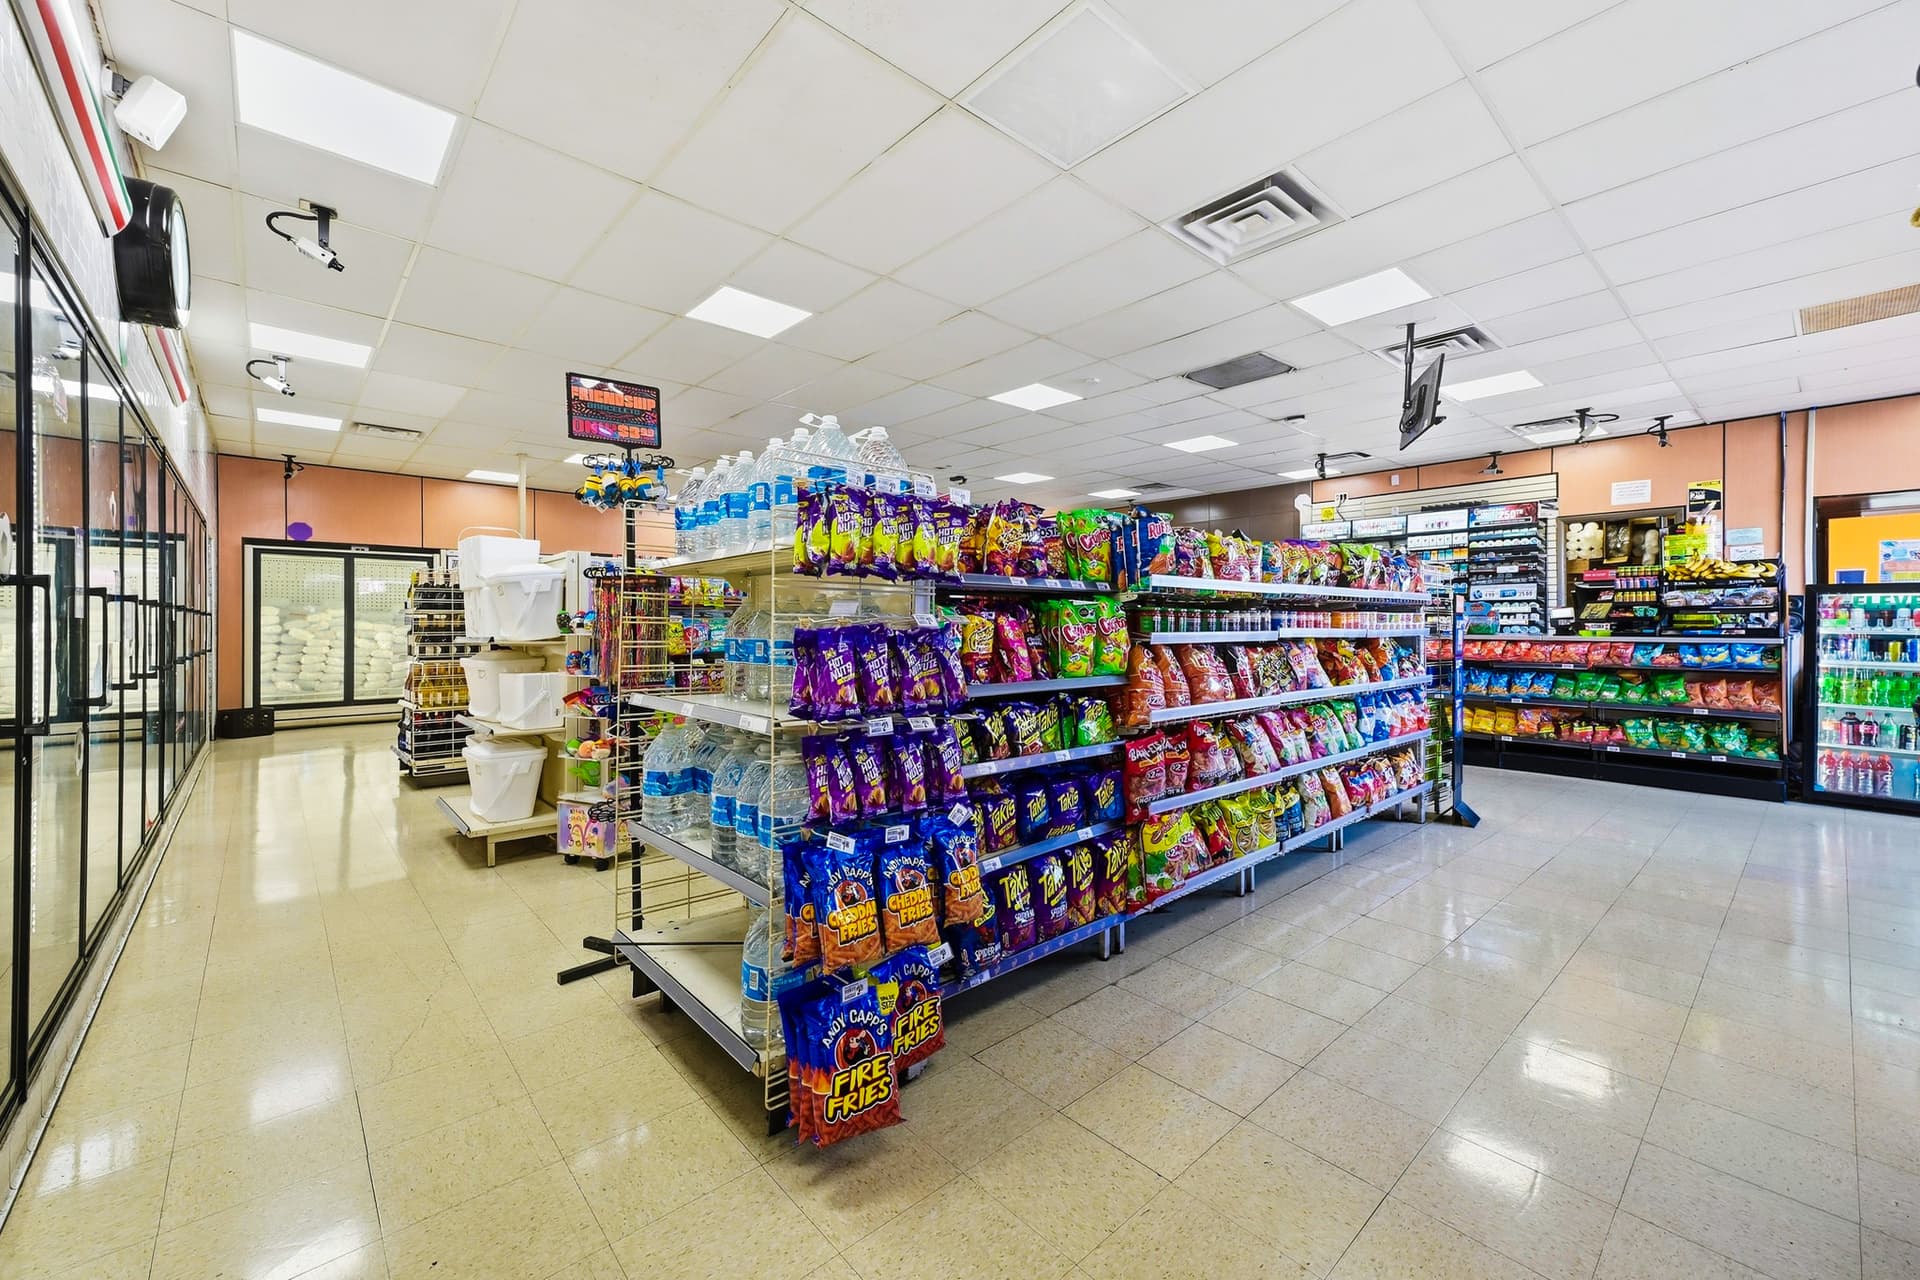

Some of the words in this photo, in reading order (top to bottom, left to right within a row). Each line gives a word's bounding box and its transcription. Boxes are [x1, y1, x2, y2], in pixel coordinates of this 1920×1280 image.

[1853, 595, 1920, 611] ELEVE
[816, 765, 828, 776] HO
[1057, 789, 1079, 812] Takis
[1094, 778, 1116, 809] Takis
[1104, 840, 1130, 881] Takis
[840, 916, 878, 943] FRIES
[900, 901, 935, 927] FRIES
[903, 963, 937, 985] CAPP'S
[822, 1012, 846, 1048] ANDY
[849, 1008, 889, 1037] CAPP'S
[894, 996, 939, 1036] FIRE
[893, 1013, 940, 1056] FRIES
[833, 1055, 892, 1097] FIRE
[826, 1074, 893, 1120] FRIES
